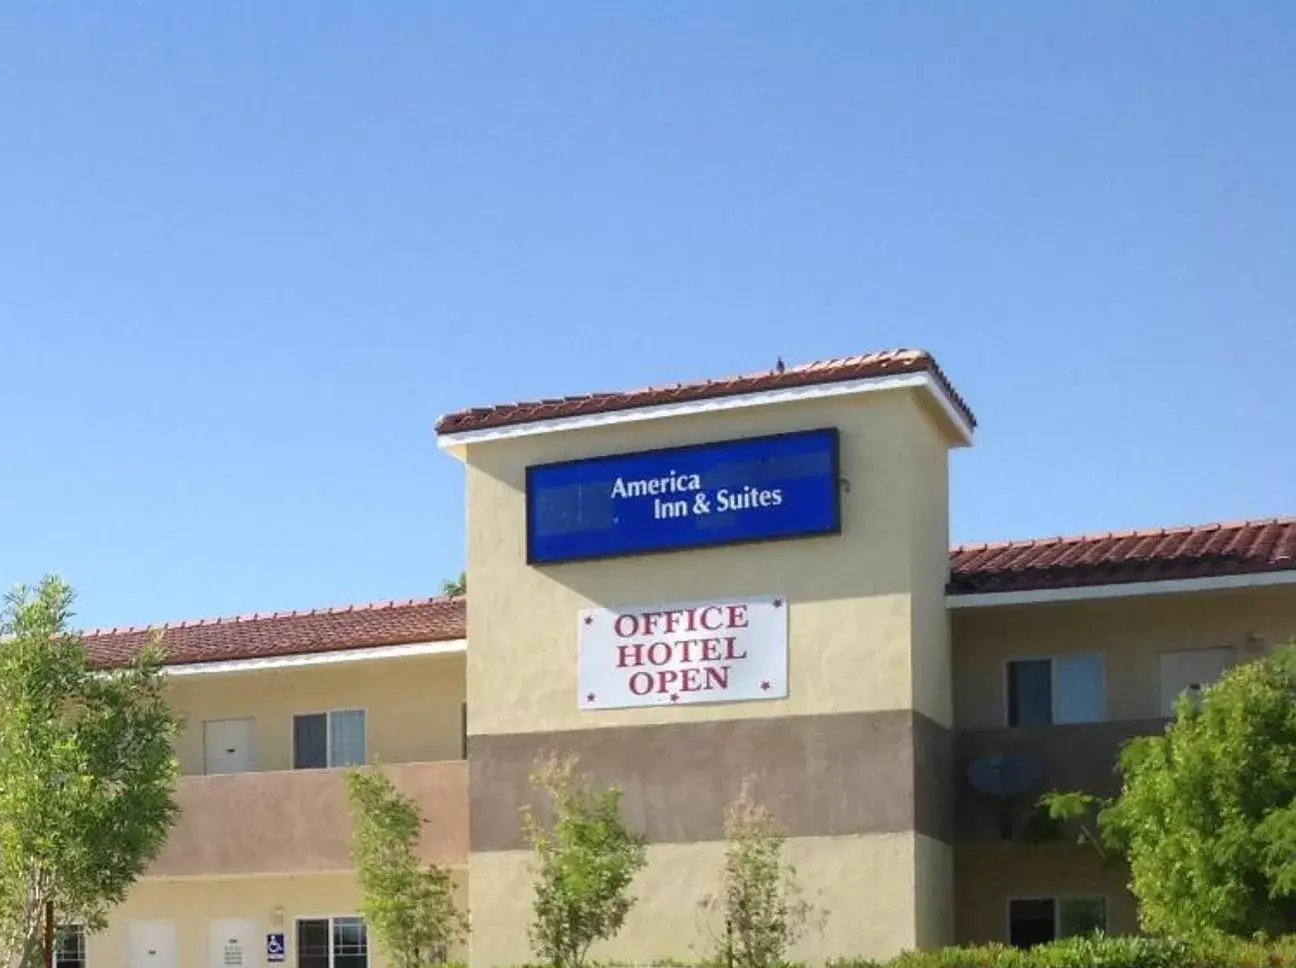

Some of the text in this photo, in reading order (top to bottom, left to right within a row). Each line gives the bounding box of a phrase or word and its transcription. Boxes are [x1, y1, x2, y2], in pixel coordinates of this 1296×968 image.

[611, 470, 701, 499] America
[653, 485, 782, 520] Inn & Suites
[614, 604, 749, 637] OFFICE
[616, 637, 747, 668] HOTEL
[628, 667, 729, 696] OPEN
